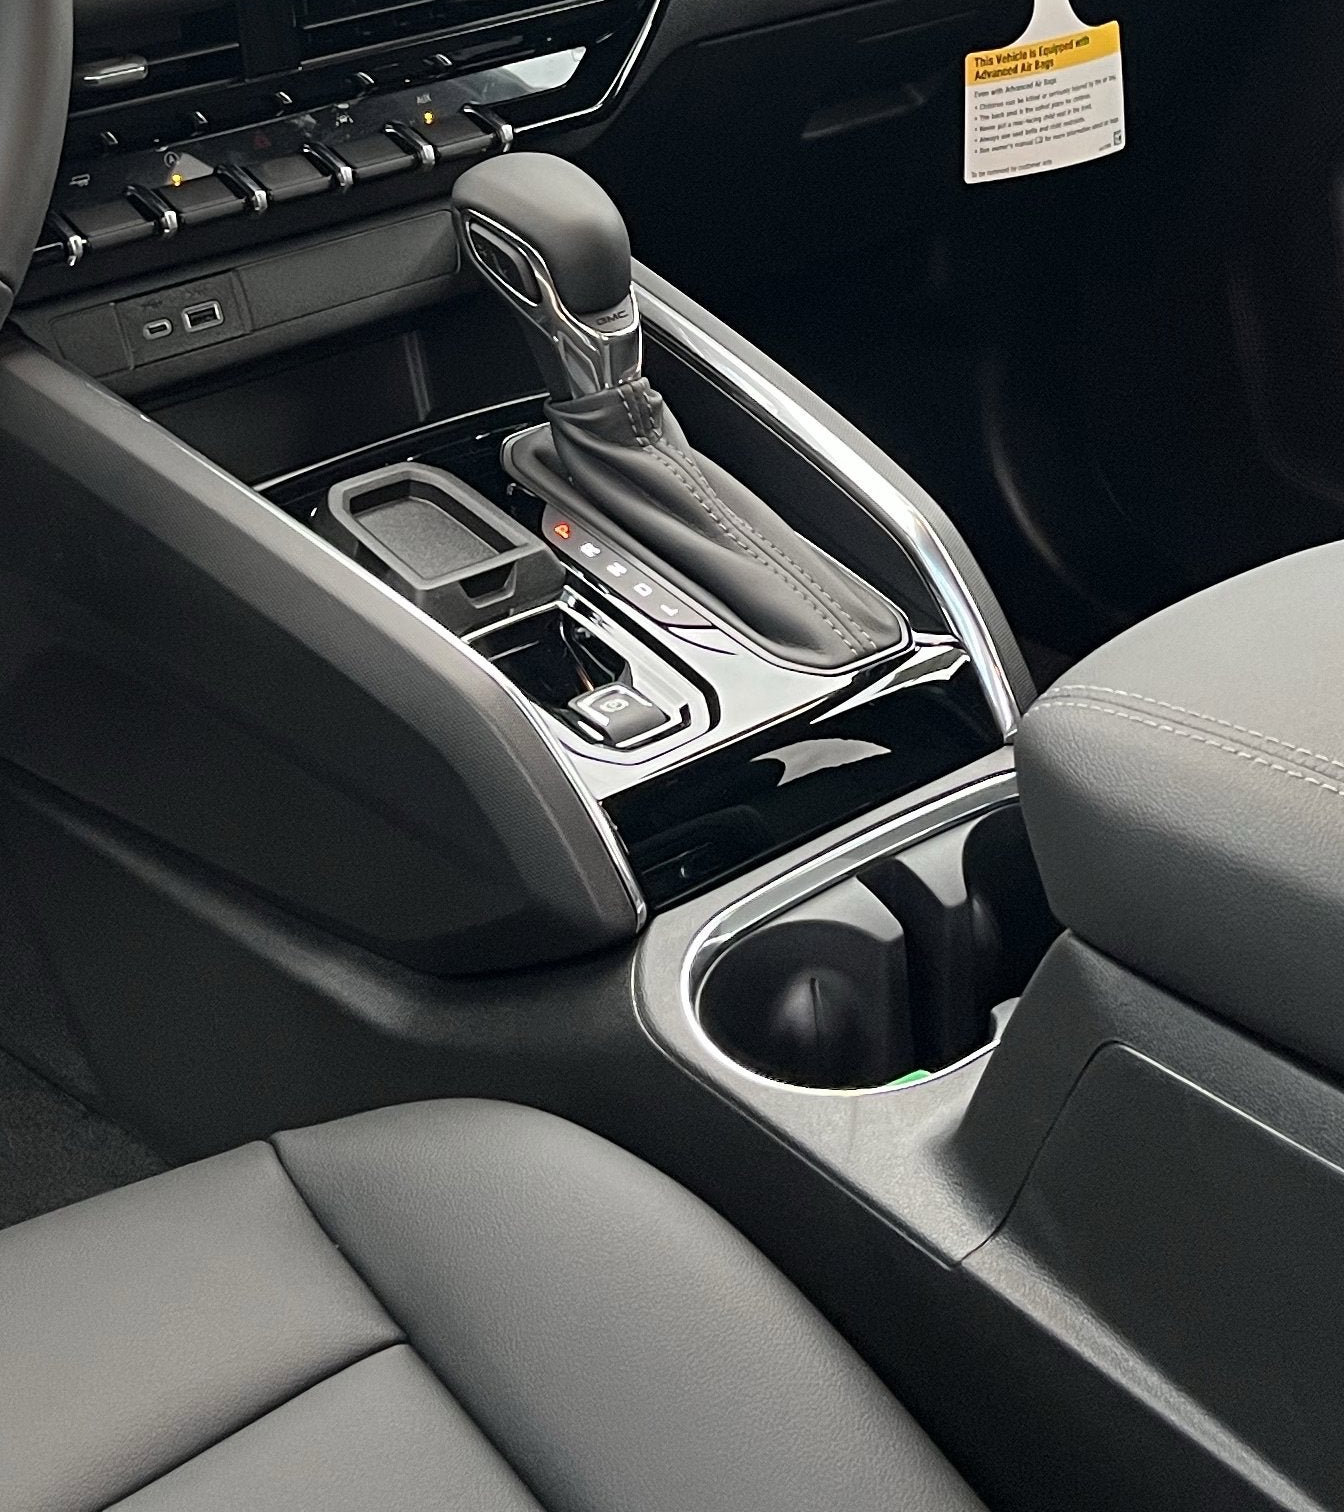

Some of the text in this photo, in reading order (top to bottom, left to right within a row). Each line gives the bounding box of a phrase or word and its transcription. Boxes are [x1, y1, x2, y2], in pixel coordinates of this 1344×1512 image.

[975, 56, 994, 69] This
[996, 50, 1027, 65] Vehicle
[1038, 40, 1074, 59] Equipped
[975, 57, 1054, 81] Advanced Air Bags
[595, 309, 630, 326] GMC
[554, 523, 571, 539] P
[579, 542, 601, 558] R
[633, 582, 653, 597] D
[660, 604, 679, 617] L
